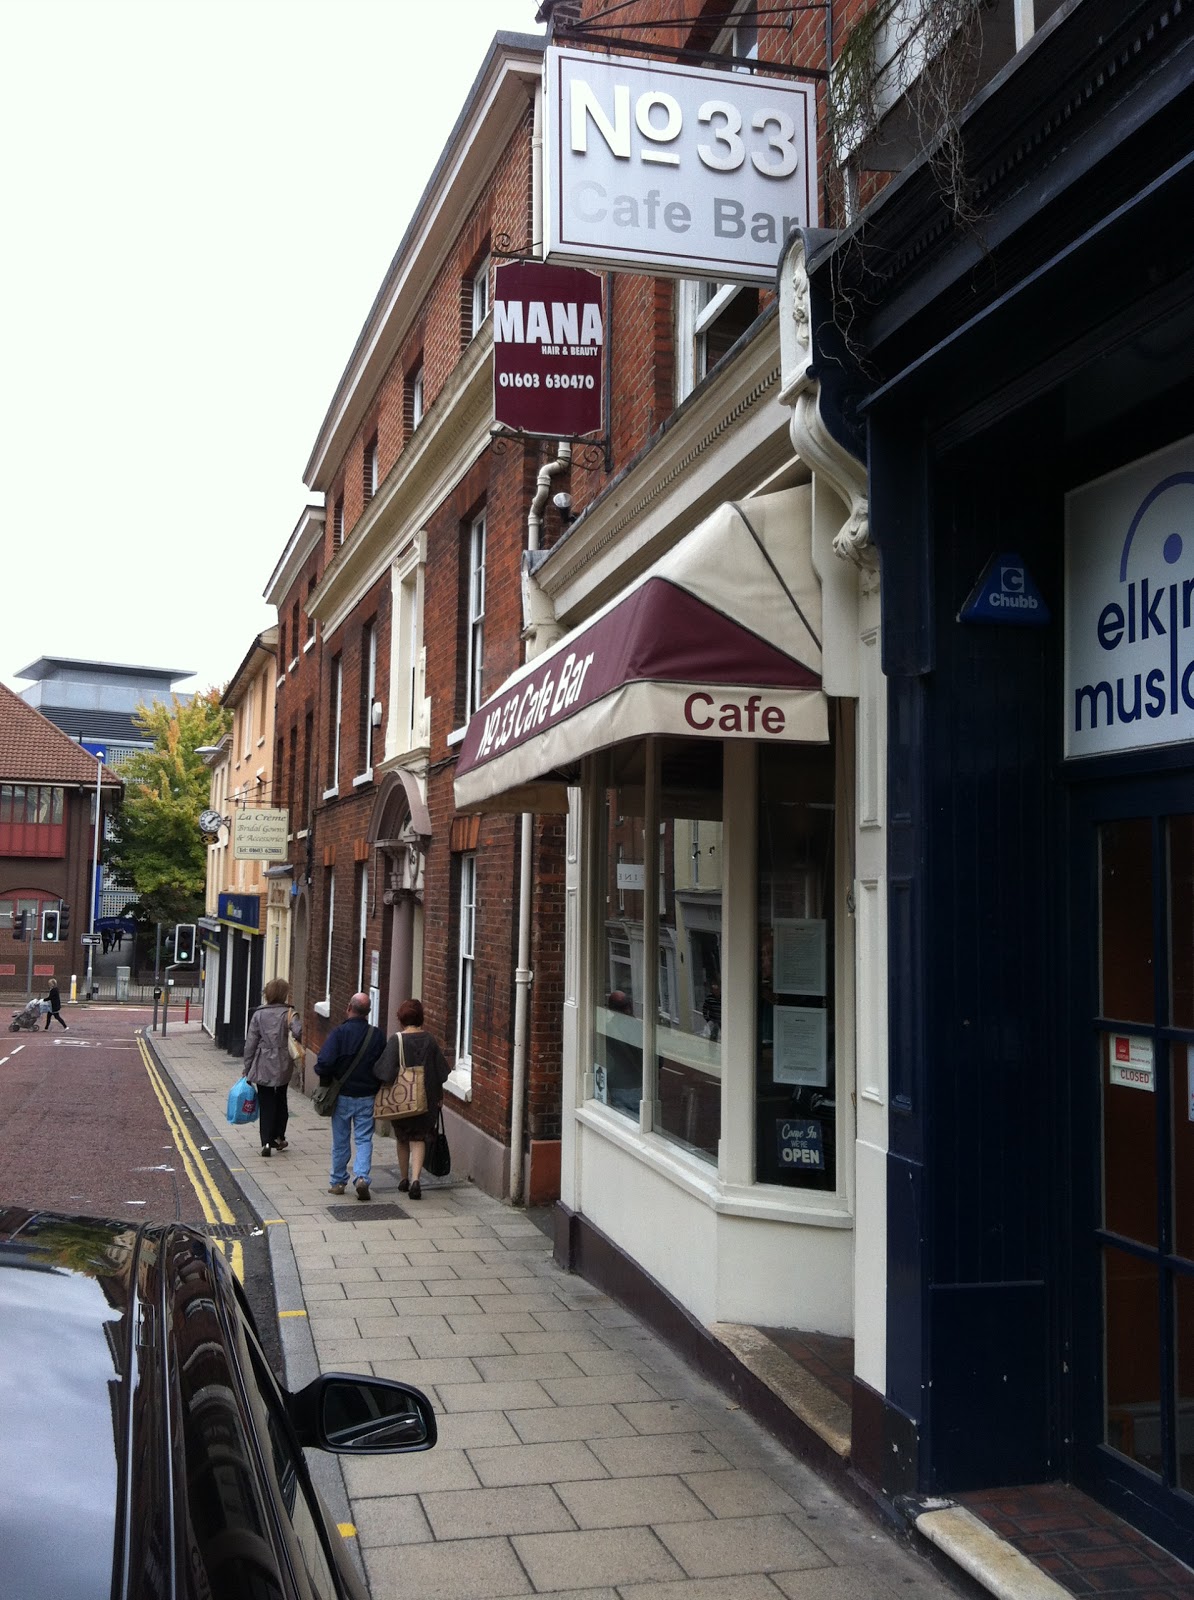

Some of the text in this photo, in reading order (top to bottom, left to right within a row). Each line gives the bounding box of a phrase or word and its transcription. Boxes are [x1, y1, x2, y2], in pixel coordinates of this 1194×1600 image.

[697, 100, 799, 179] 33
[572, 179, 800, 245] Cafe Bar
[494, 300, 604, 346] MANA
[541, 345, 599, 357] HAIR & BEAUTY
[499, 372, 595, 389] 01603 630470
[989, 592, 1039, 609] Chubb
[494, 694, 520, 751] 33
[514, 669, 556, 739] Cafe
[550, 651, 595, 717] Bar
[683, 691, 786, 734] Cafe
[237, 813, 252, 821] La
[237, 824, 286, 834] Bridal Gowns
[246, 834, 285, 843] Accessories
[1120, 1069, 1150, 1084] CLOSED
[781, 1123, 817, 1140] Come In
[782, 1147, 820, 1164] OPEN
